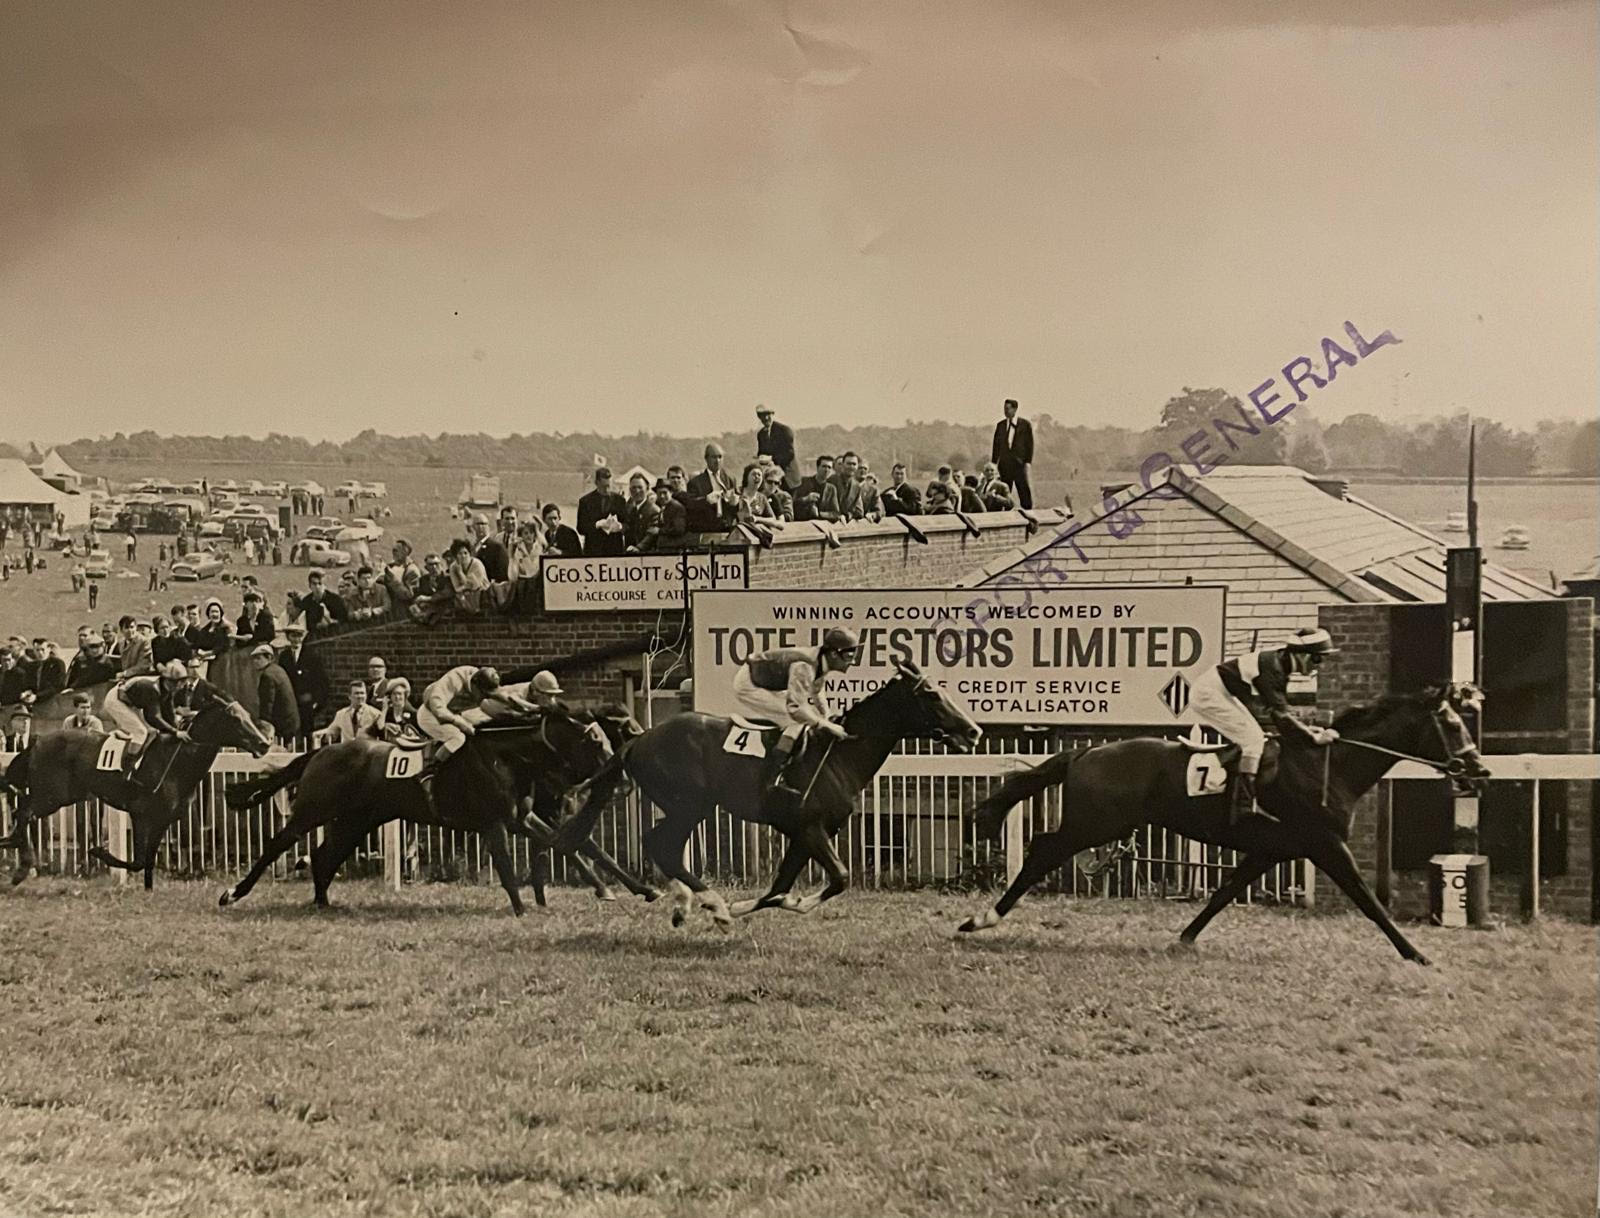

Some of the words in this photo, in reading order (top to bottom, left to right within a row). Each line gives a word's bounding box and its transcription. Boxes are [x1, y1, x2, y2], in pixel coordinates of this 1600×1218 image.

[664, 568, 673, 581] &
[576, 590, 648, 602] RACECOURSE
[772, 606, 854, 620] WINNING
[865, 606, 976, 620] ACCOUNTS
[988, 605, 1102, 619] WELCOMED
[1114, 604, 1136, 619] BY
[708, 627, 796, 667] TOTE
[810, 627, 1014, 668] IVESTORS
[1032, 625, 1203, 668] LIMITED
[957, 680, 1028, 695] CREDIT
[1035, 680, 1122, 694] SERVICE
[967, 699, 1109, 713] TOTALISATOR
[734, 731, 750, 751] 4
[102, 750, 115, 768] 11
[391, 756, 409, 776] 10
[1196, 766, 1210, 792] 7
